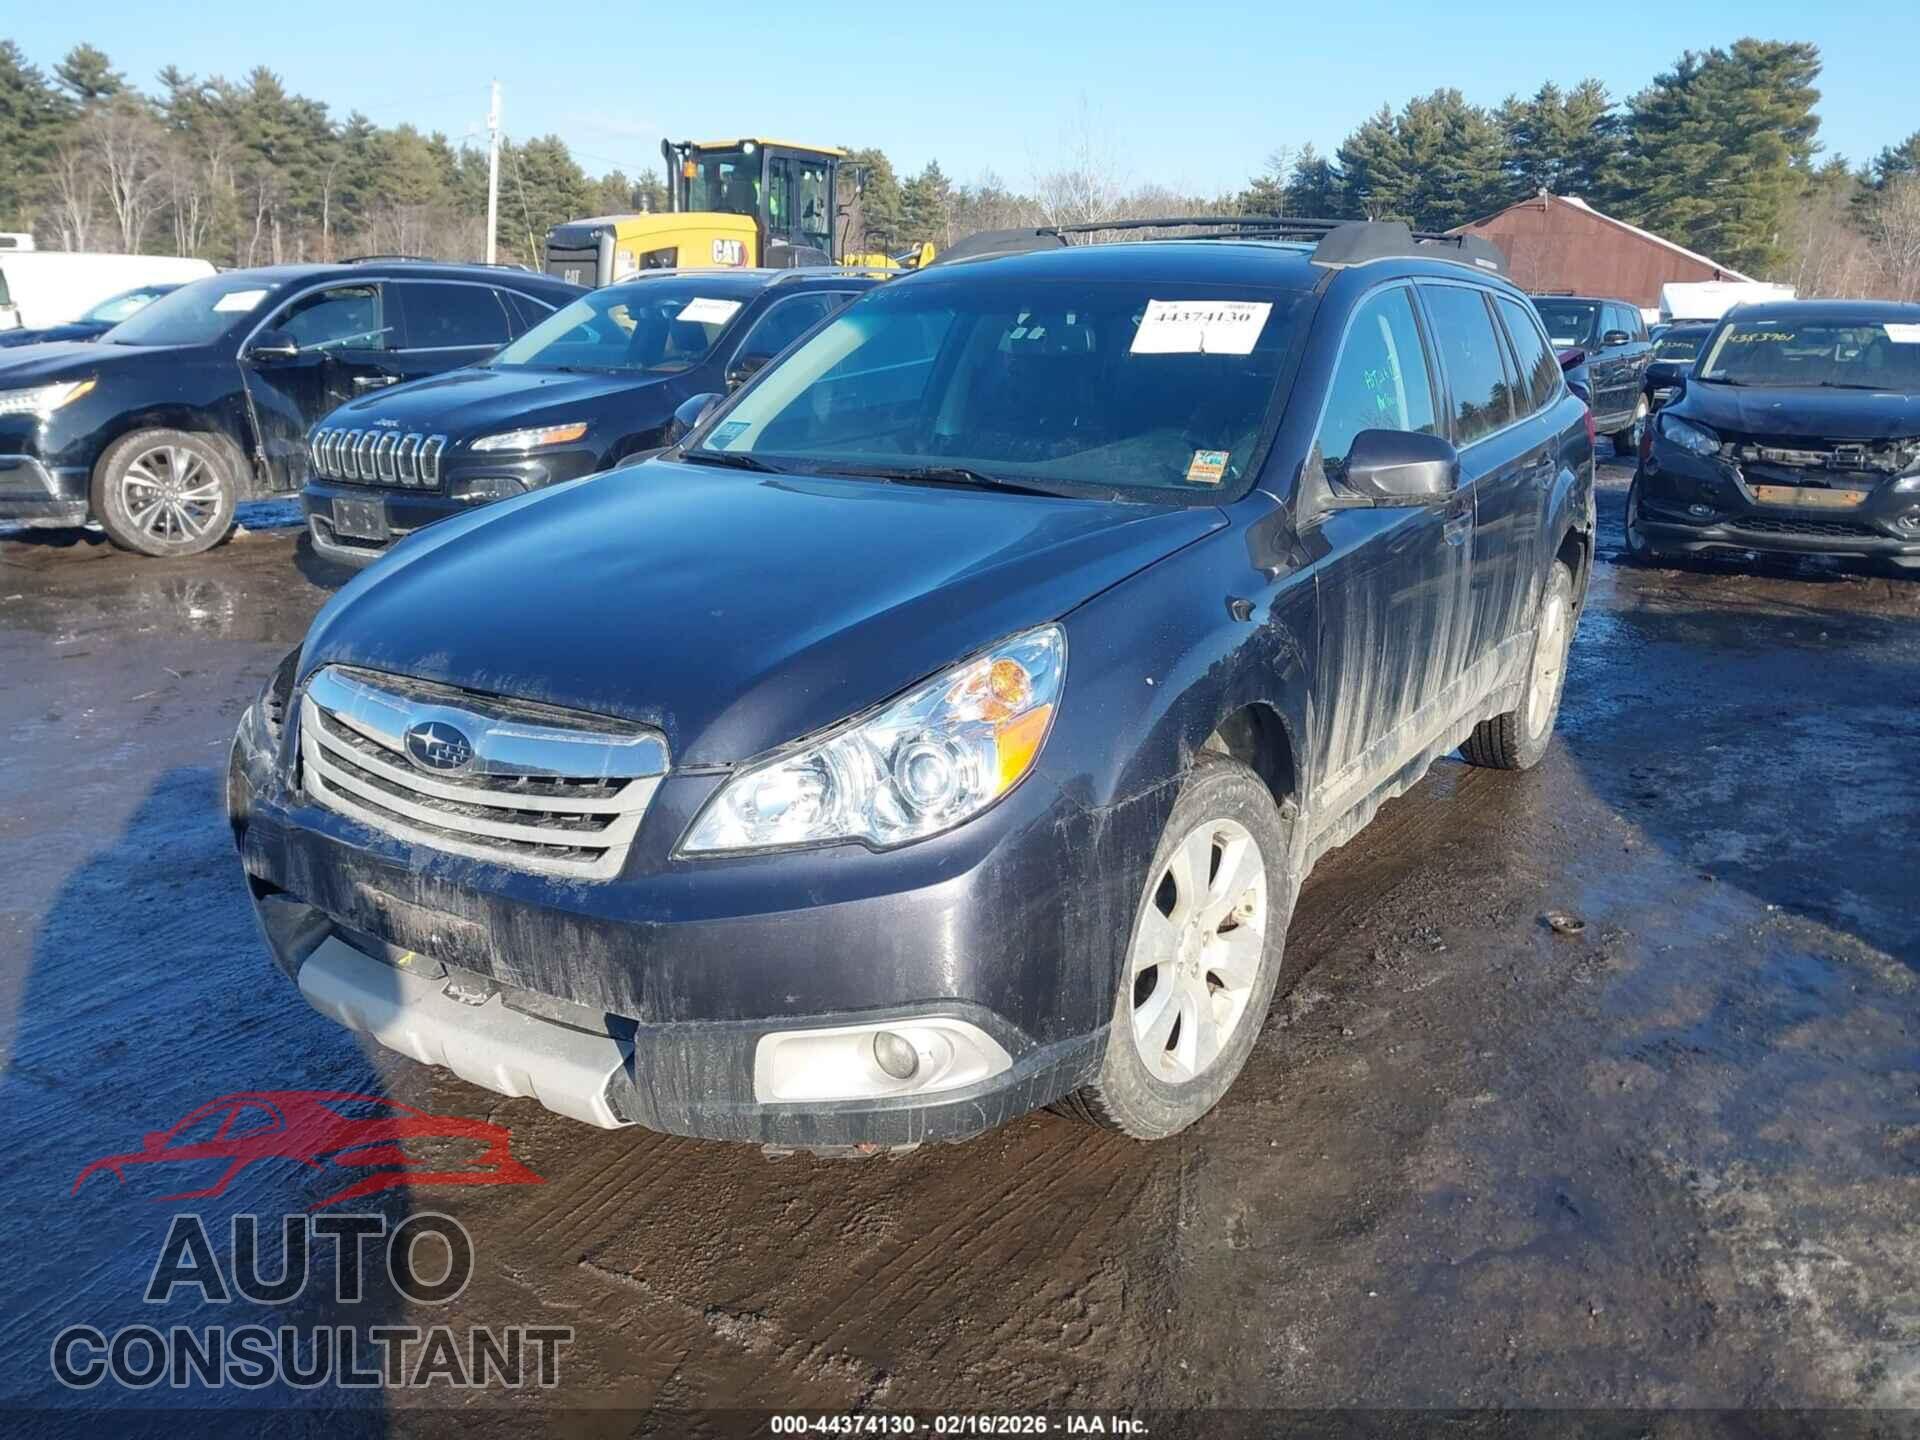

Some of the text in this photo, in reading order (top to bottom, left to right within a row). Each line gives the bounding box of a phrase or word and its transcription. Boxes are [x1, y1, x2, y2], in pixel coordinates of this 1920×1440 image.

[712, 240, 743, 264] CAT
[564, 270, 582, 285] CAT
[1154, 311, 1251, 322] 44374130
